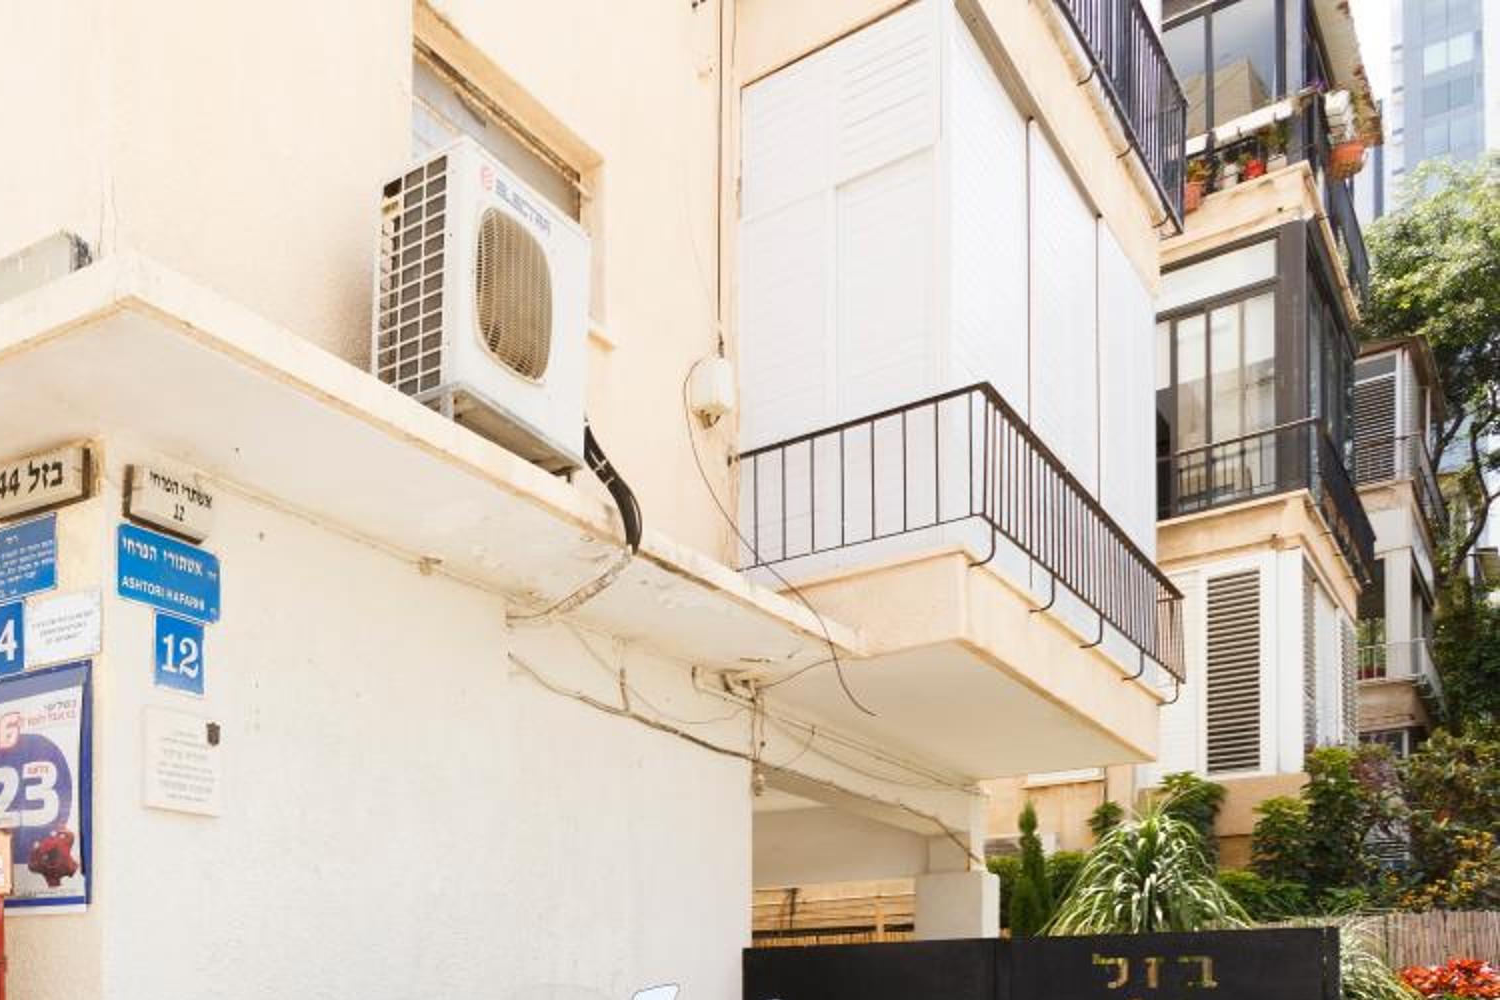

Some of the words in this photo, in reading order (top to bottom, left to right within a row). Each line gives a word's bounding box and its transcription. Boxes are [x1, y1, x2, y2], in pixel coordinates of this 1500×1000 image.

[27, 459, 64, 493] בזל
[173, 503, 186, 522] 12
[161, 632, 200, 676] 12
